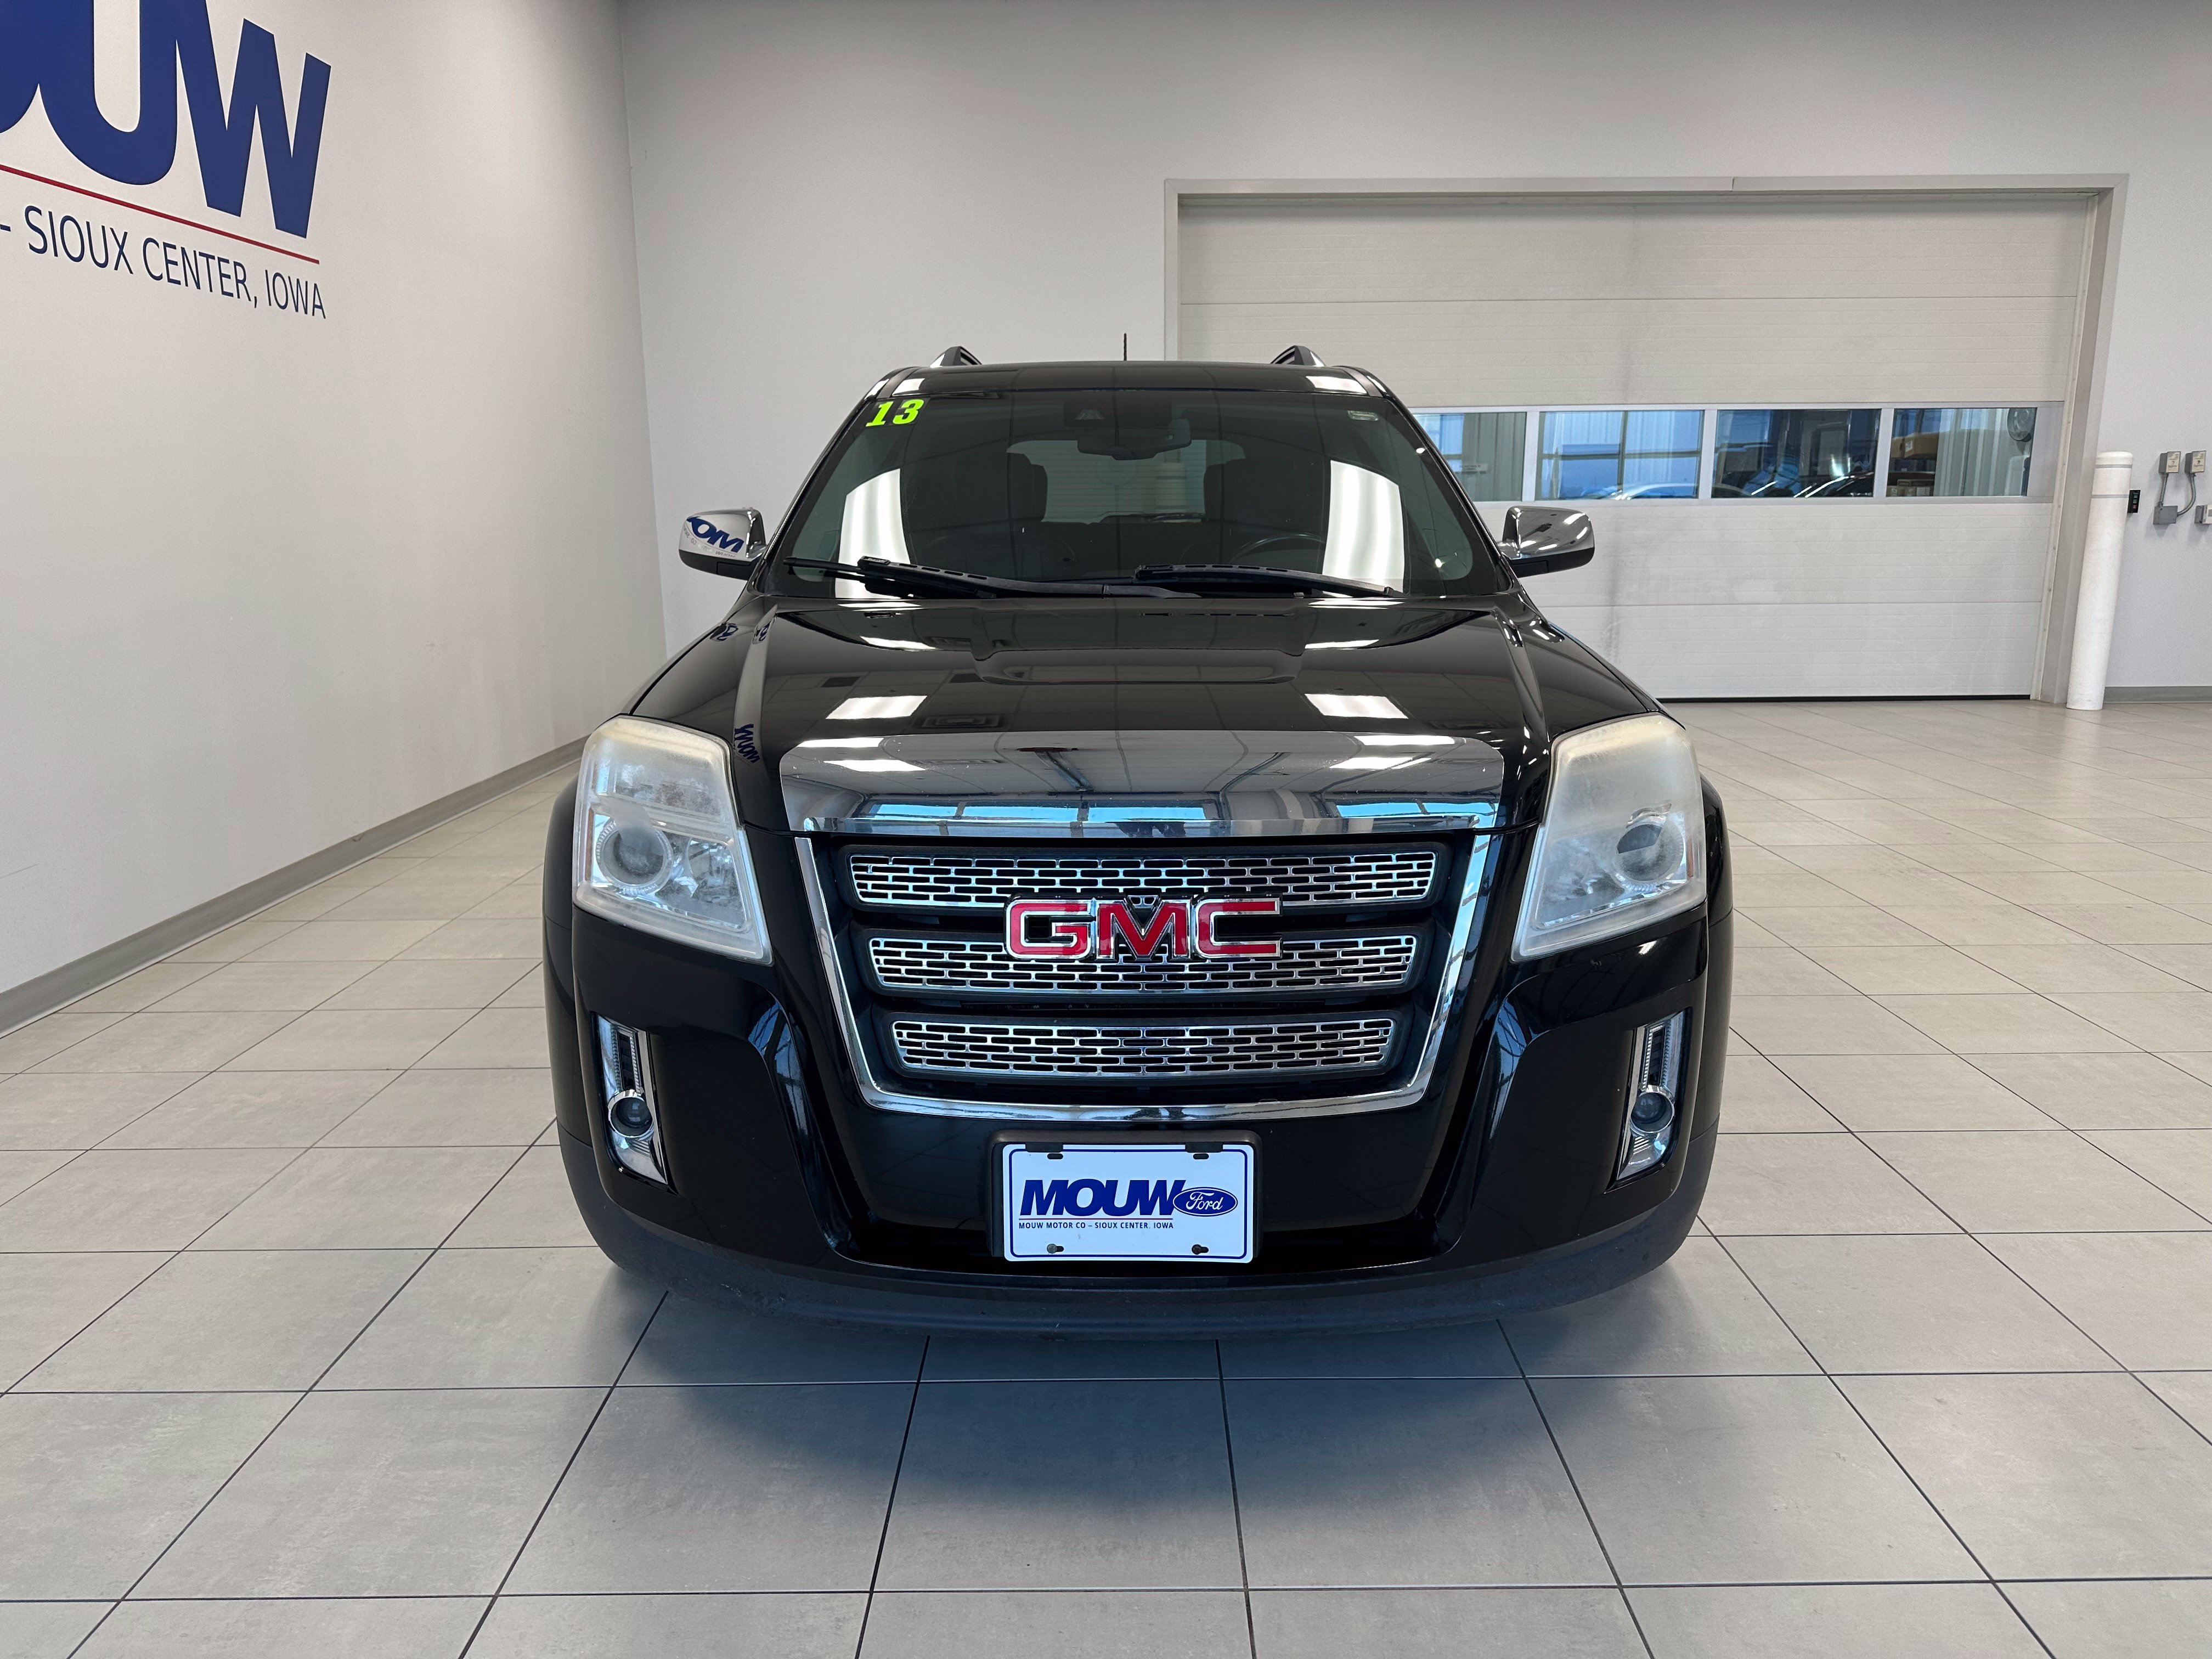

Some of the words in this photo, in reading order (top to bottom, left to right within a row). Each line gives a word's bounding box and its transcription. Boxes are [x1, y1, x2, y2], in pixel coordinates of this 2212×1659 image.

[0, 0, 331, 239] UW
[24, 205, 133, 274] SIOUX
[142, 237, 258, 308] CENTER,
[264, 268, 326, 319] IOWA
[865, 398, 924, 427] 13
[1005, 897, 1283, 960] GMC
[1019, 1178, 1186, 1217] MOUW
[1186, 1191, 1224, 1210] Ford
